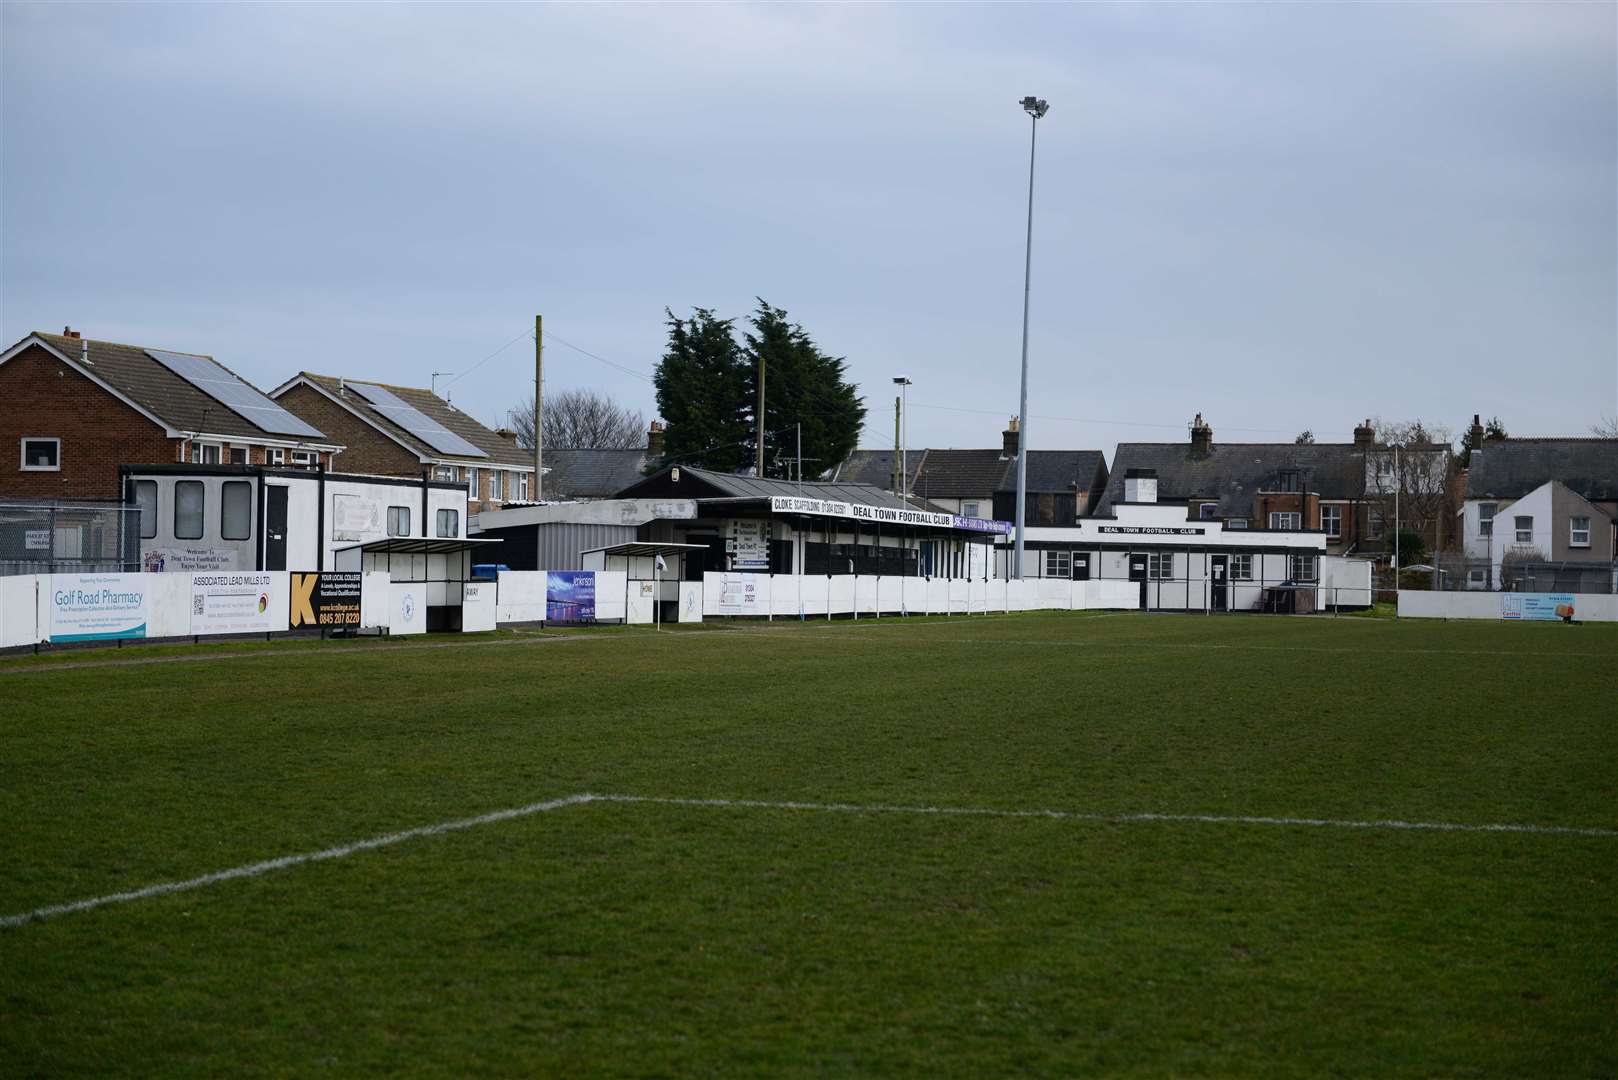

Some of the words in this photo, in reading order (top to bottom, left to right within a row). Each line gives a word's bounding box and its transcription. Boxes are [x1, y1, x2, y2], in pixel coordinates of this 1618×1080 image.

[774, 498, 792, 510] CLOKE
[794, 500, 820, 512] SCAFFOLDING
[853, 506, 872, 518] DEAL
[874, 508, 896, 520] TOWN
[899, 511, 932, 524] FOOTBALL
[934, 515, 950, 526] CLUB
[194, 577, 227, 585] ASSOCIATED
[229, 577, 242, 585] LEAD
[244, 577, 259, 585] MILLS
[260, 576, 270, 584] LTD
[573, 576, 594, 586] Jenkinson
[55, 590, 75, 605] Golf
[78, 590, 99, 604] Road
[102, 589, 143, 606] Pharmacy
[291, 574, 318, 628] K
[320, 613, 333, 624] 0845
[334, 613, 345, 624] 207
[346, 613, 359, 624] 8220
